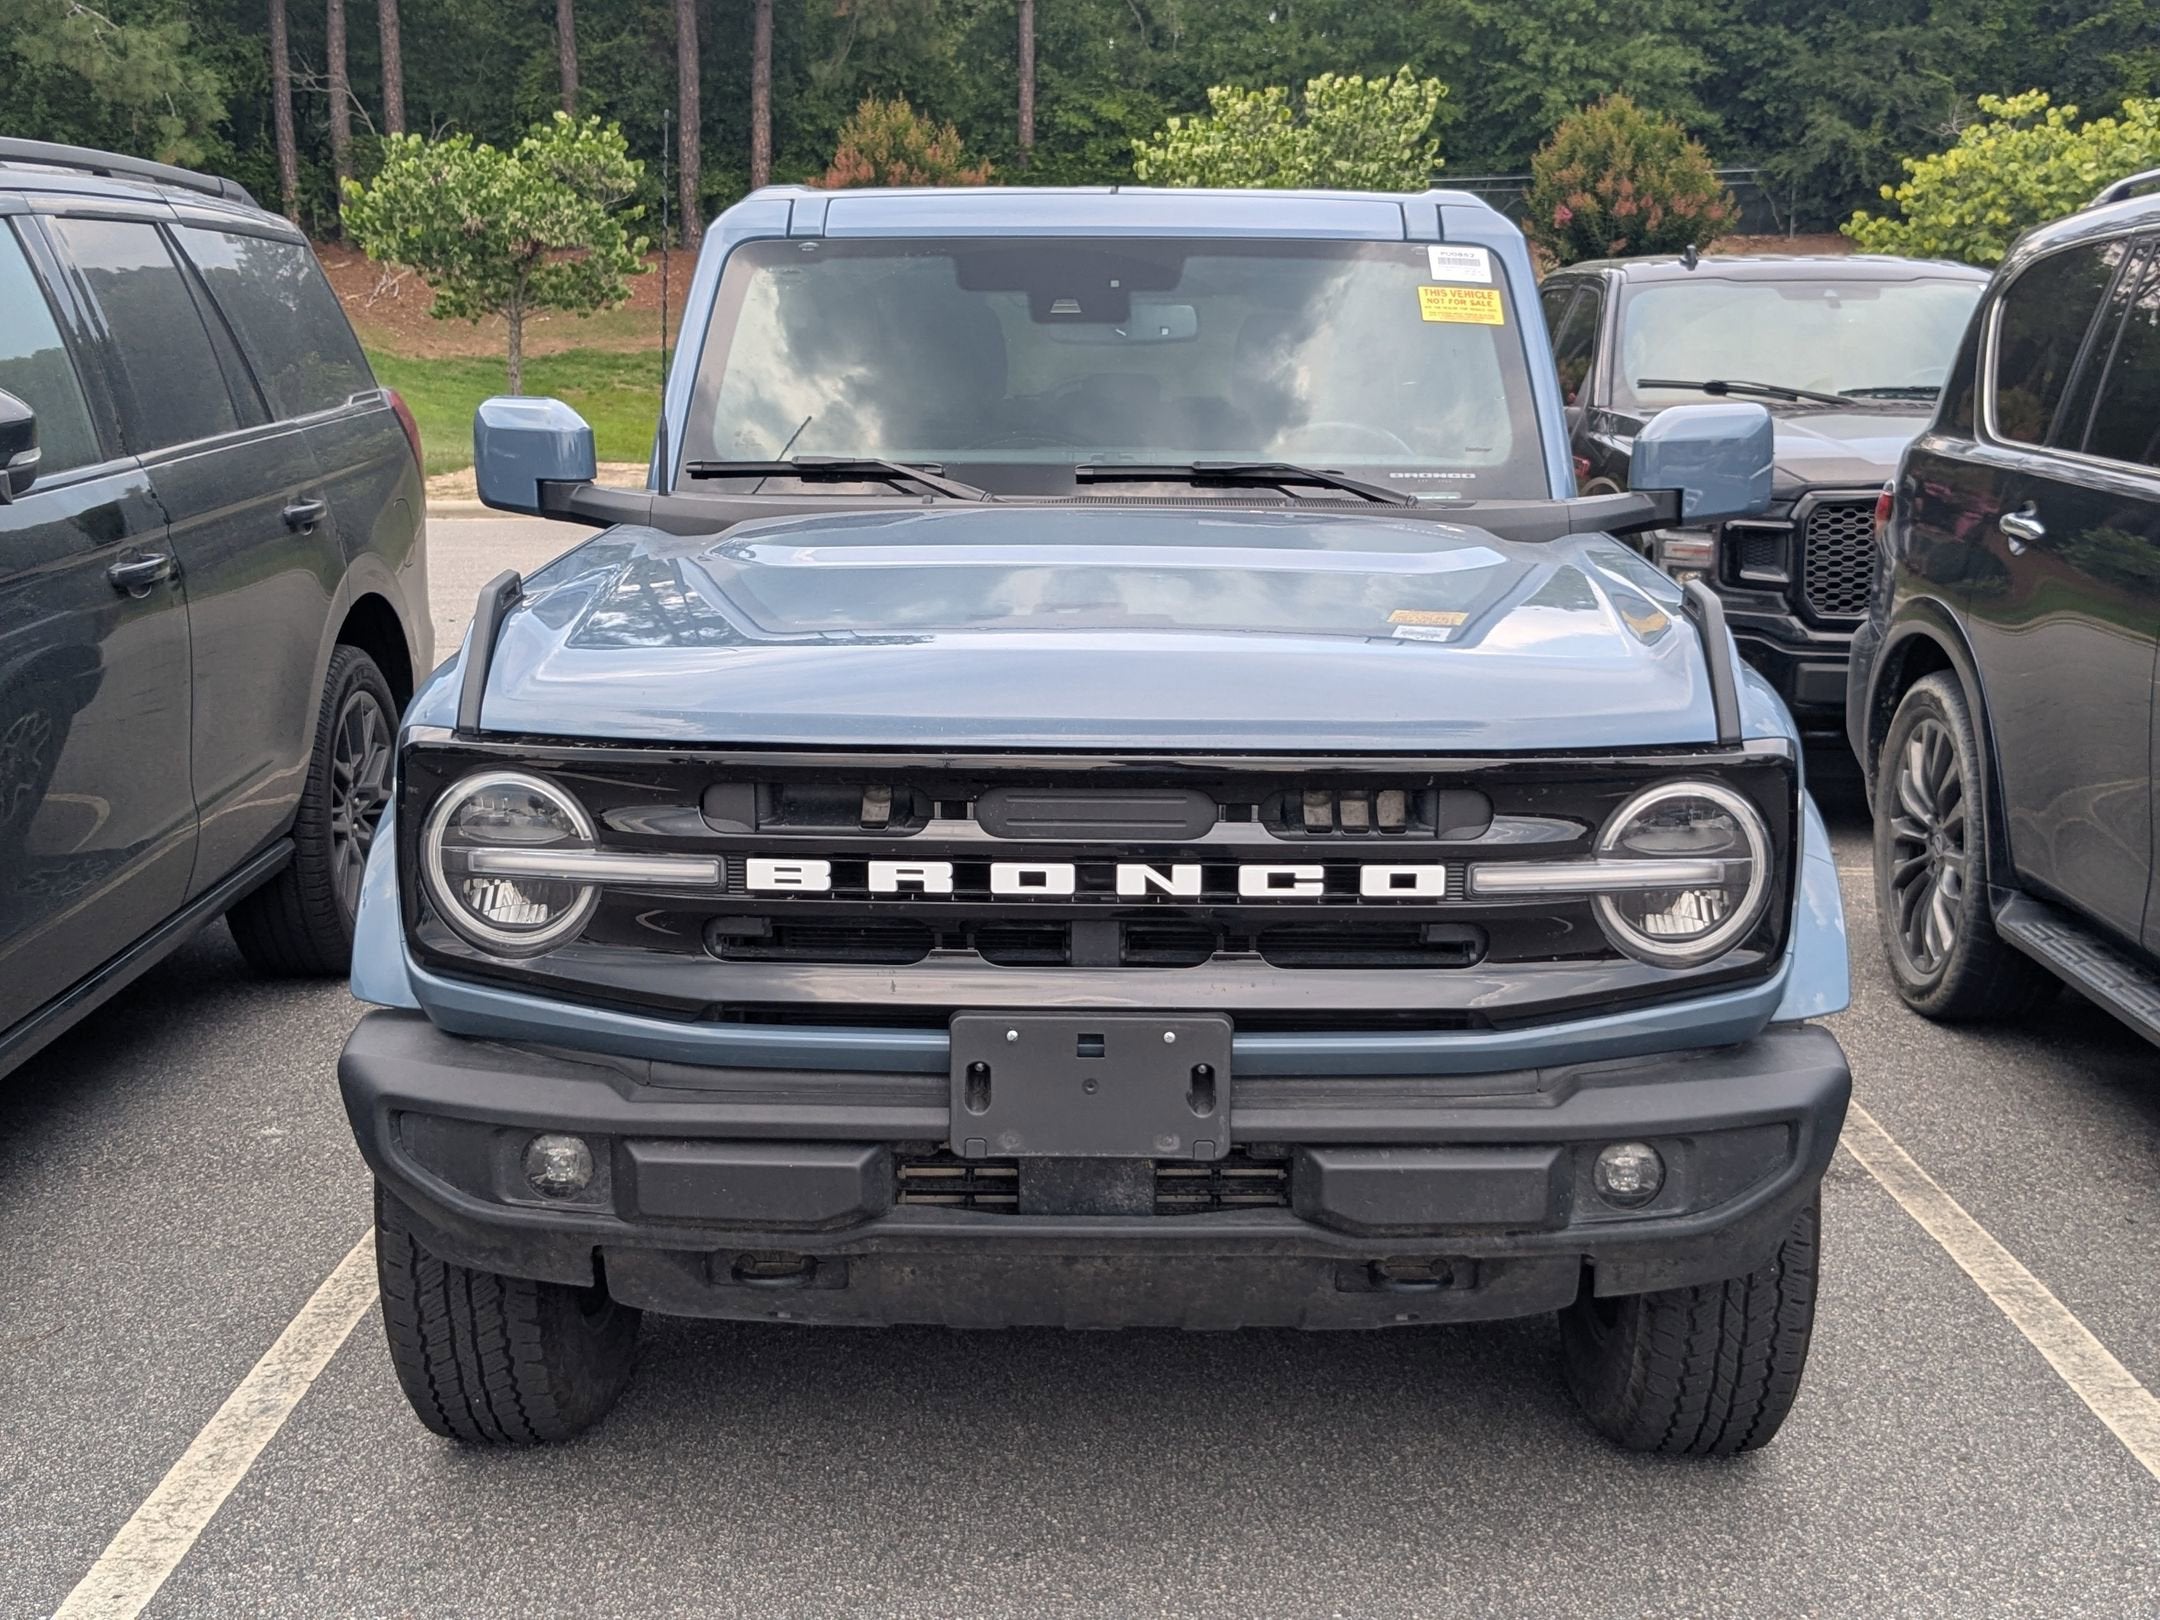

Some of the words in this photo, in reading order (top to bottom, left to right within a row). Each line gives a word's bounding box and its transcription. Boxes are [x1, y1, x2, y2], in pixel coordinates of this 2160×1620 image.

[1424, 288, 1447, 297] THIS
[1450, 289, 1494, 300] VEHICLE
[1470, 299, 1493, 307] SALE
[746, 858, 1445, 898] BRONCO
